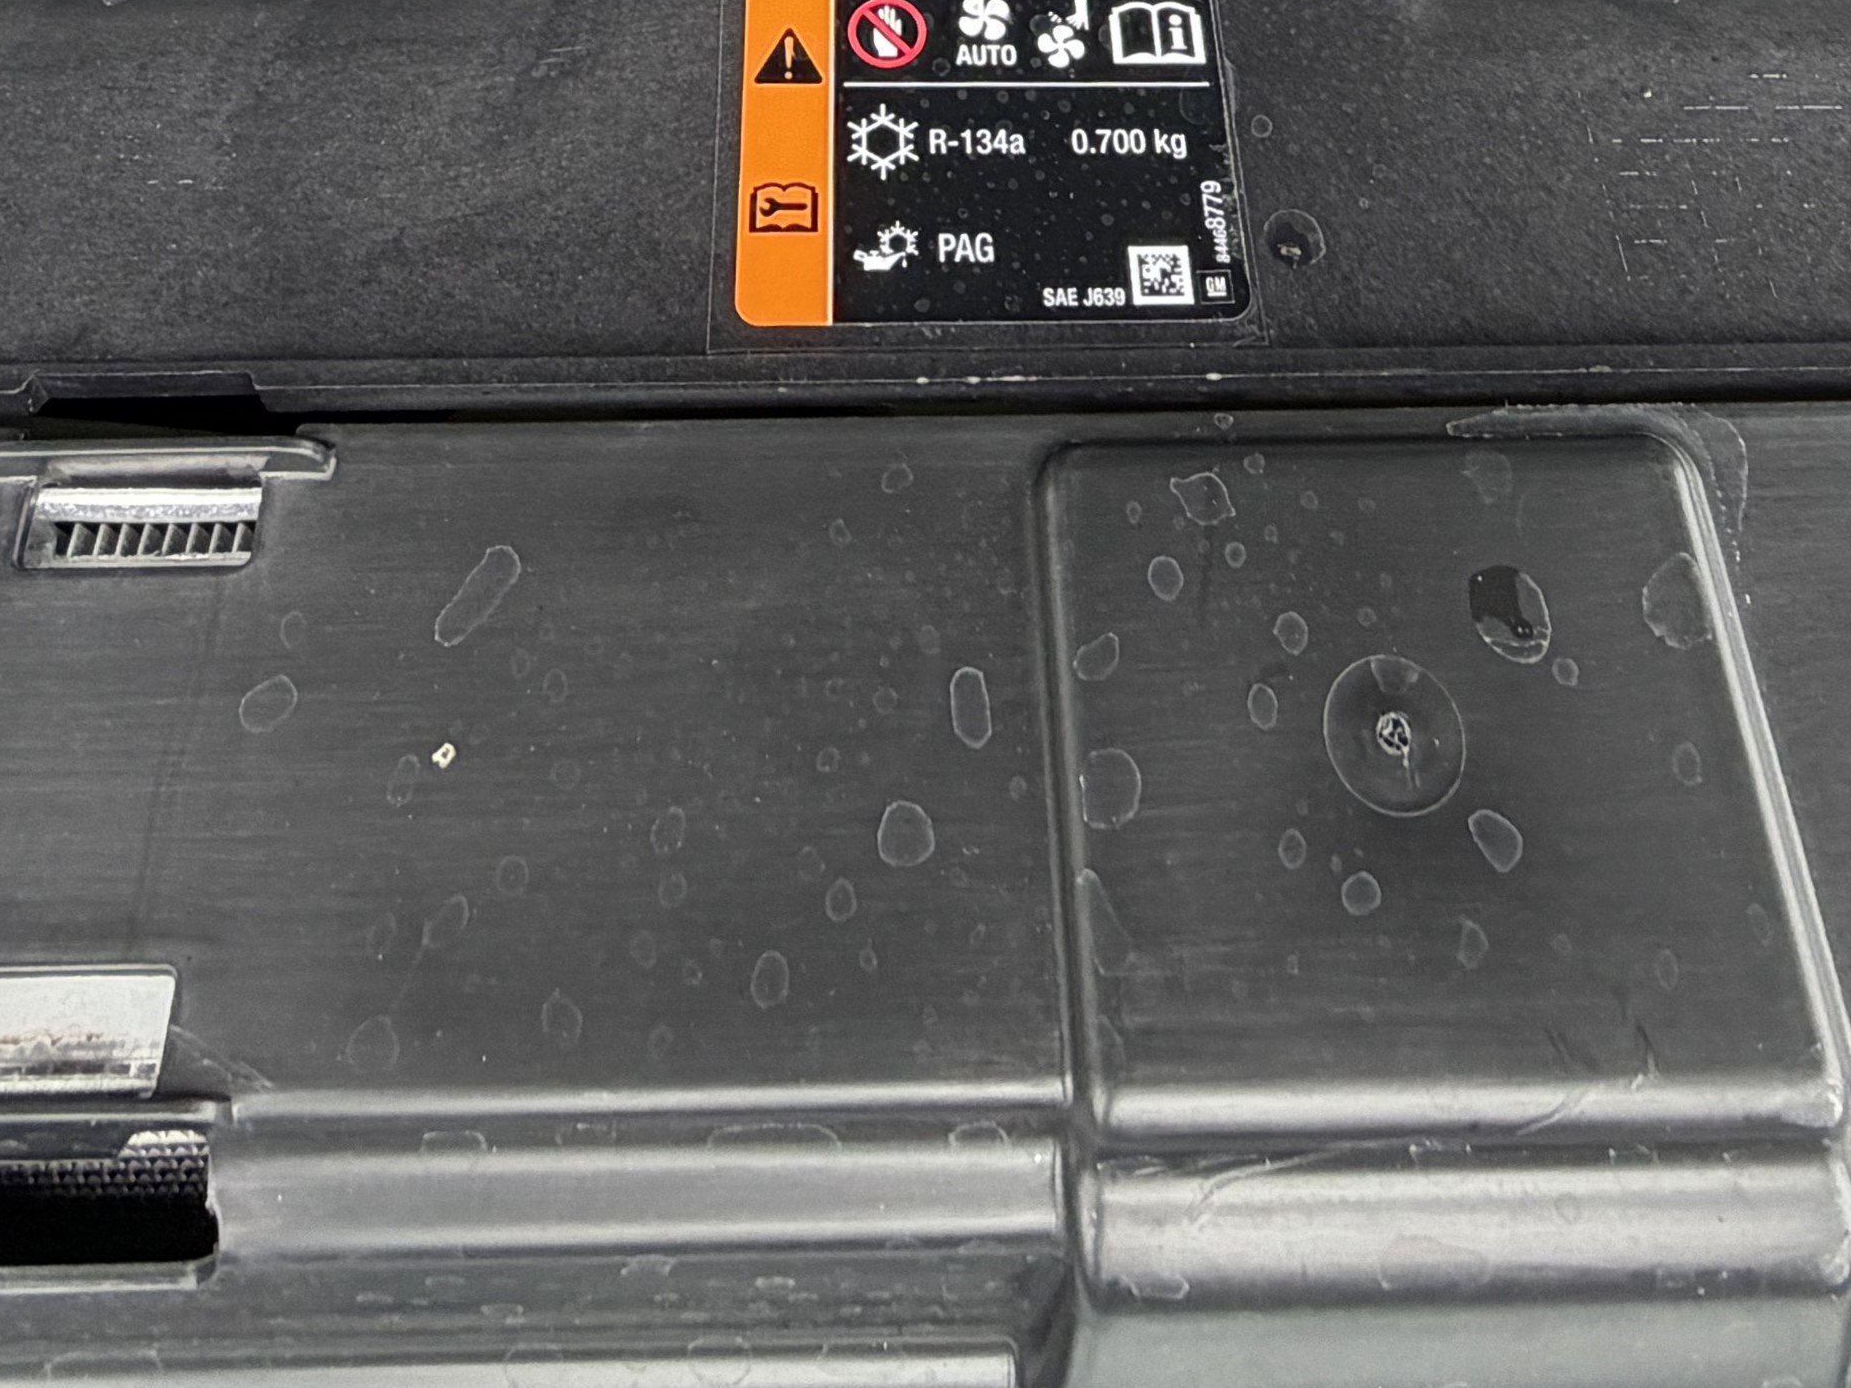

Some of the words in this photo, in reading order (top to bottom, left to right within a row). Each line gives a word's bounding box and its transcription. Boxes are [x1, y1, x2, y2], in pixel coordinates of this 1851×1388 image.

[956, 44, 1017, 66] AUTO
[928, 129, 1025, 156] R-134a
[1071, 128, 1146, 155] 0.700
[1154, 128, 1188, 159] kg
[938, 232, 995, 264] PAG
[1206, 276, 1228, 295] GM
[1042, 287, 1079, 307] SAE
[1082, 287, 1126, 307] J639
